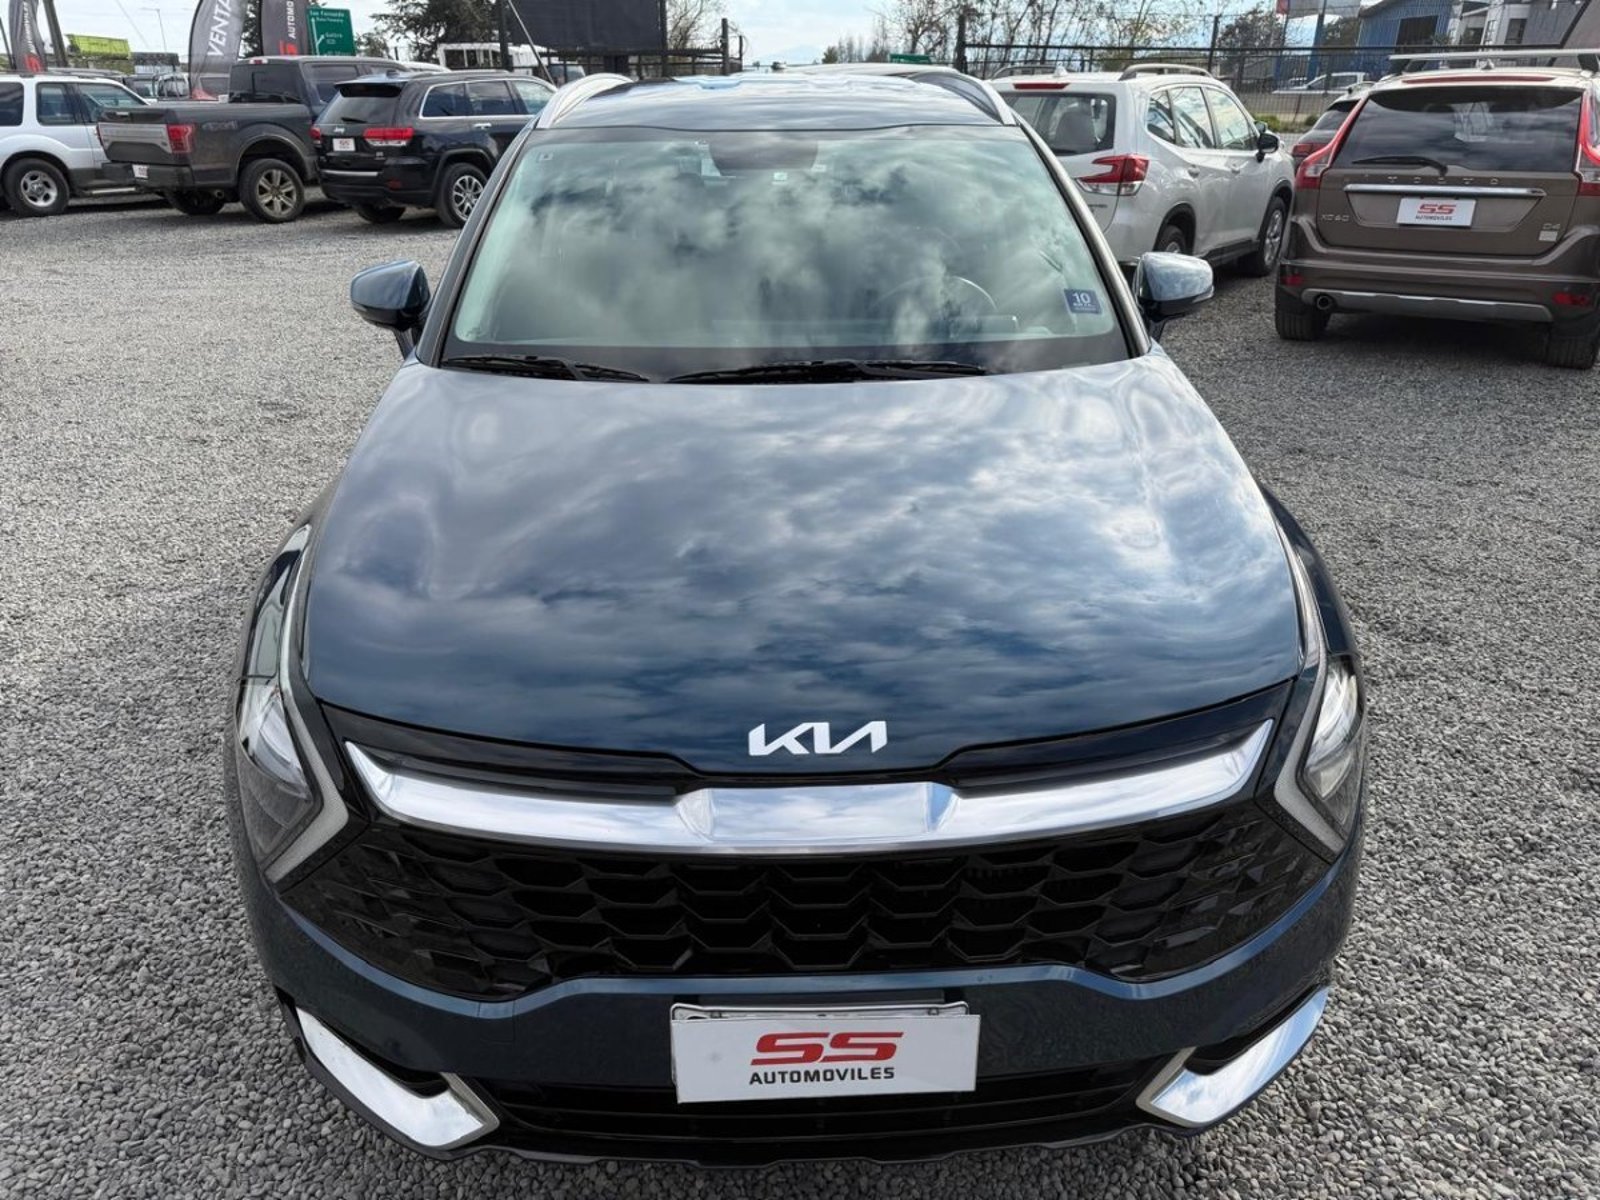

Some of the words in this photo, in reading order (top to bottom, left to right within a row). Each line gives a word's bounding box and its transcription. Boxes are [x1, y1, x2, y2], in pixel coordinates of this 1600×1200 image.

[1417, 204, 1457, 215] SS
[1072, 292, 1092, 304] 10
[748, 720, 888, 756] KIA
[750, 1031, 904, 1066] SS
[749, 1066, 895, 1086] AUTOMOVILES
